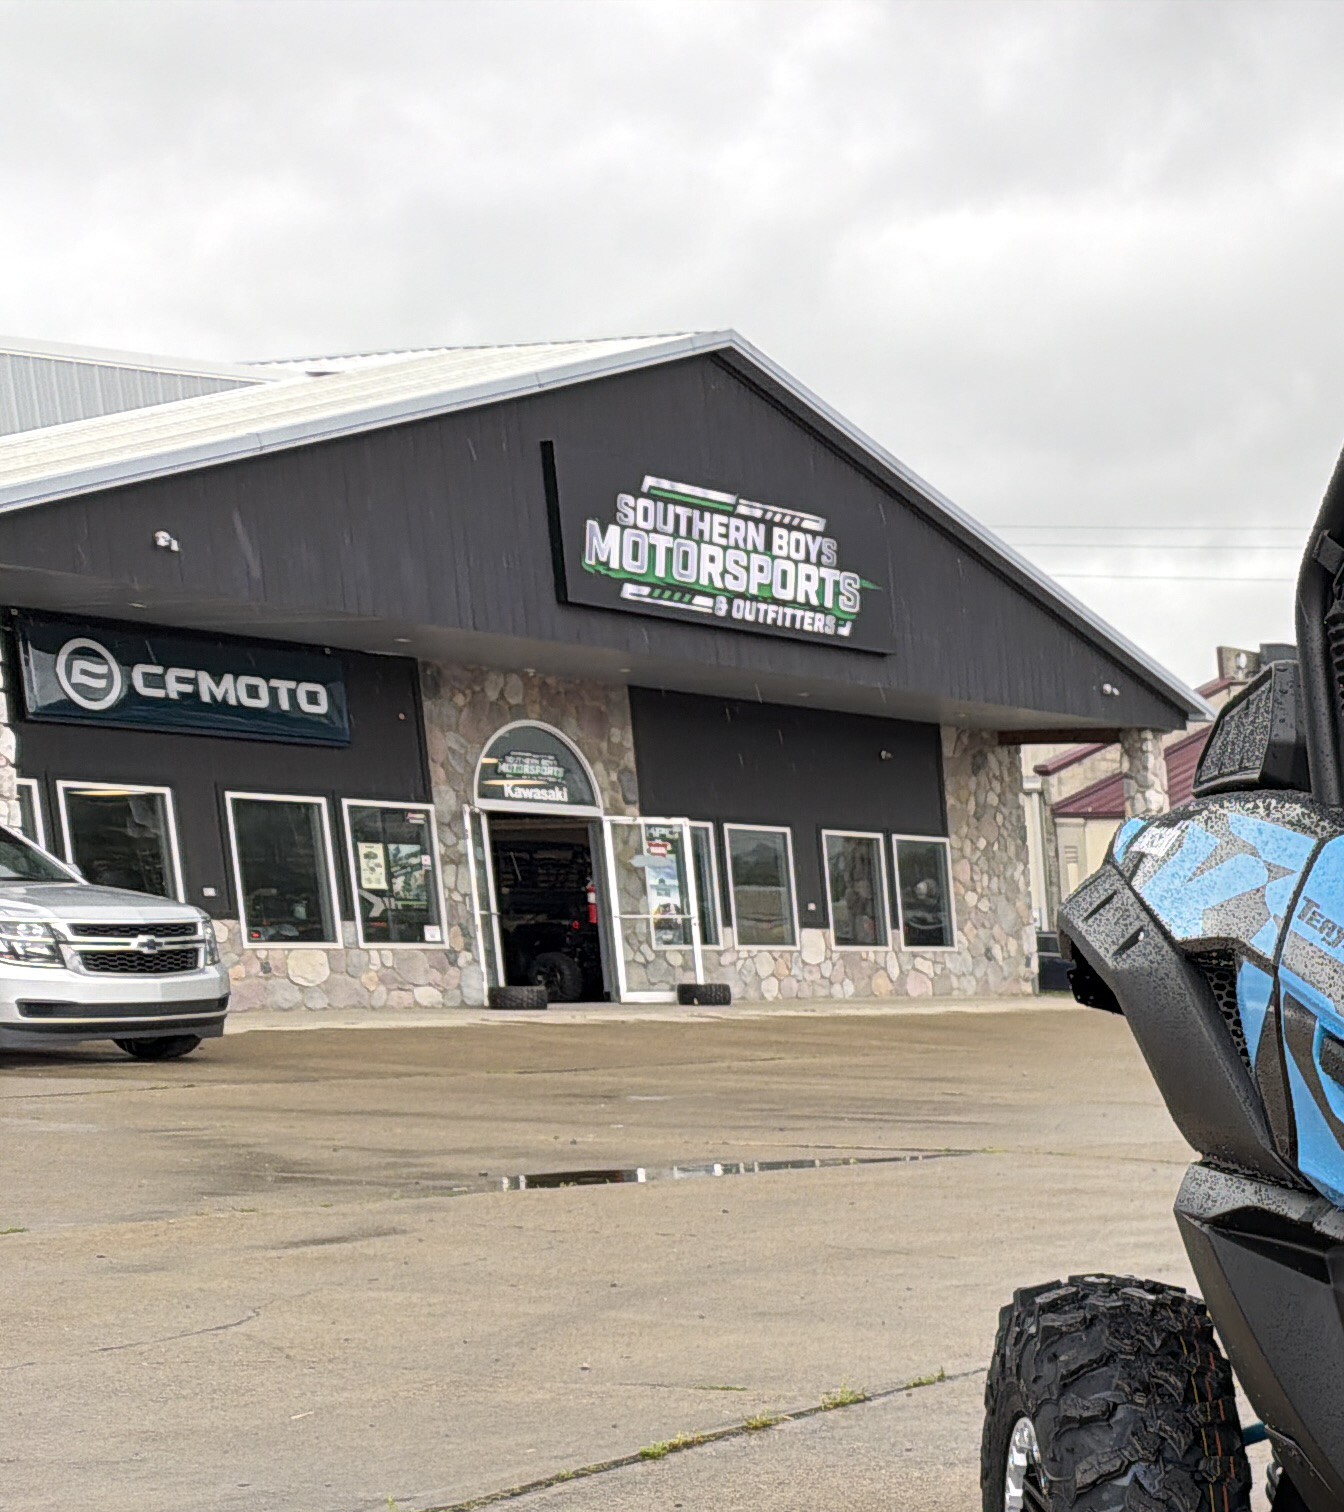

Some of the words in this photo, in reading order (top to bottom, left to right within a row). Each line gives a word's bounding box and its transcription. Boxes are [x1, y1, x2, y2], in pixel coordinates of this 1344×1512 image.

[616, 493, 765, 552] SOUTHERN
[771, 525, 838, 567] BOYS
[585, 519, 861, 614] MOTORSPORTS
[731, 597, 837, 634] OUTFITTERS
[131, 663, 330, 715] CFMOTO
[503, 784, 569, 802] Kawasaki
